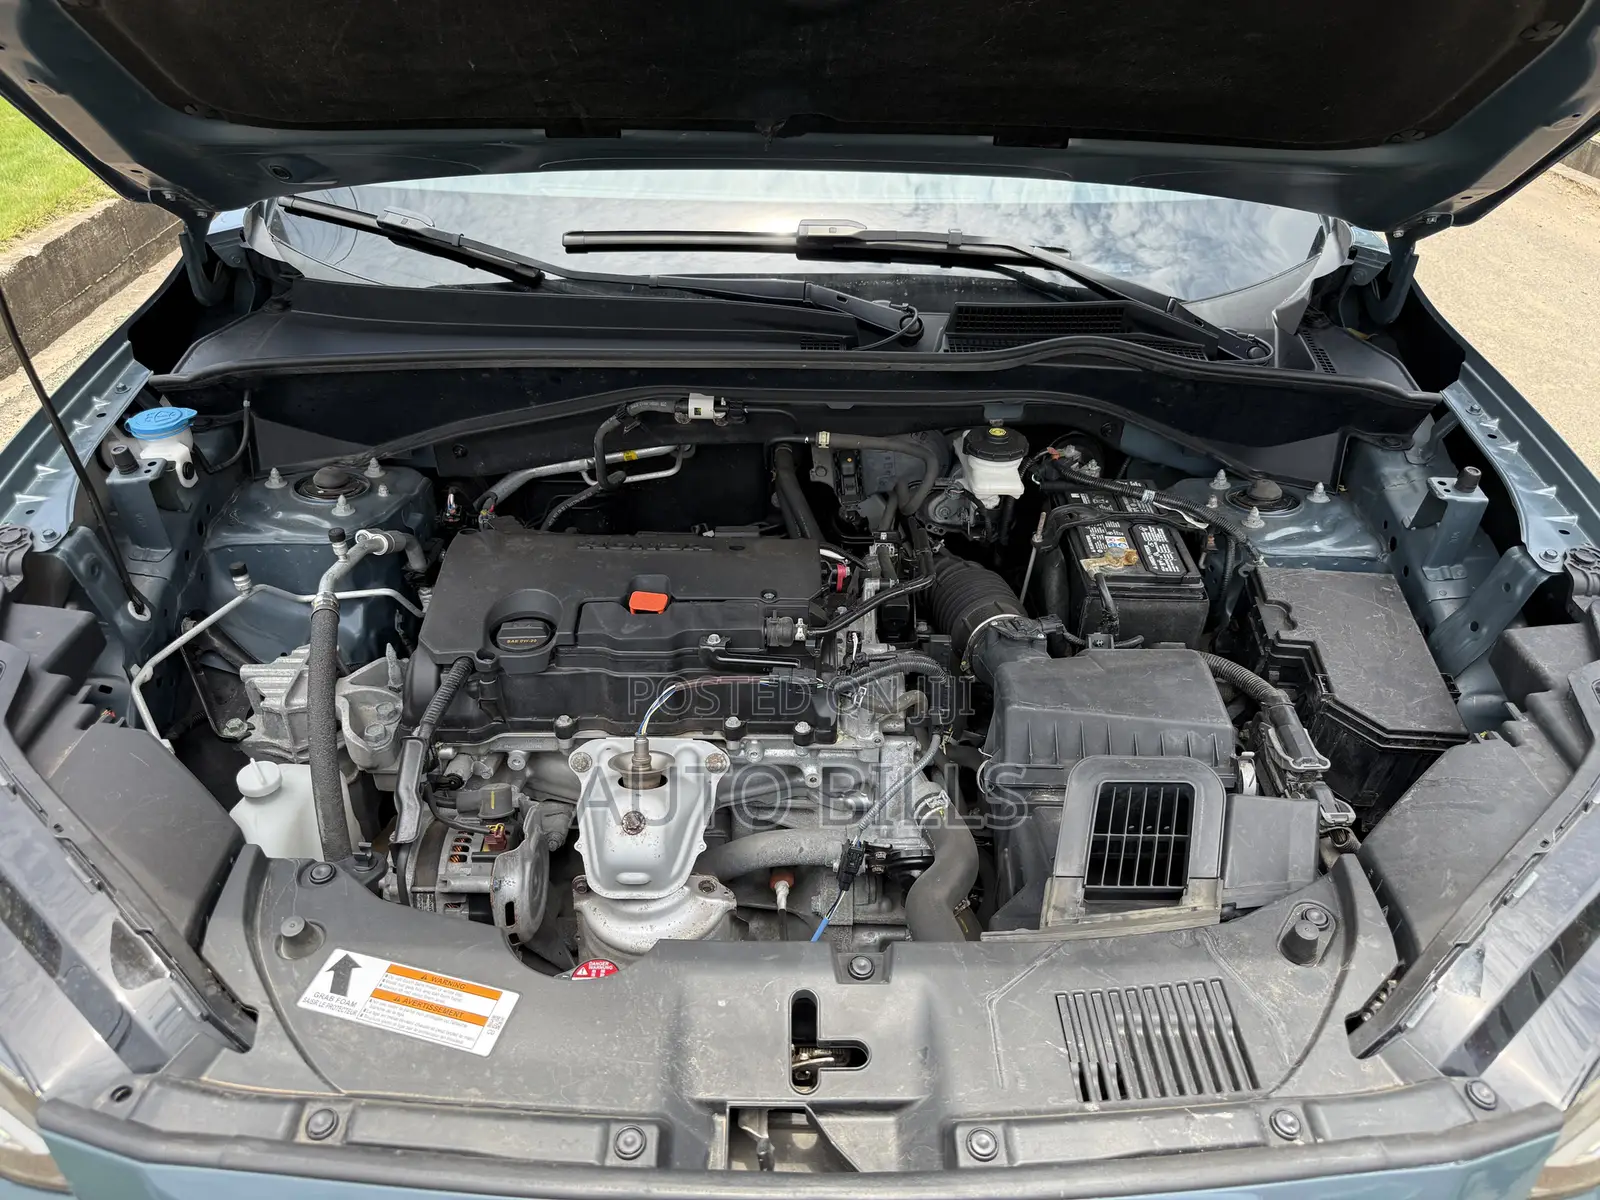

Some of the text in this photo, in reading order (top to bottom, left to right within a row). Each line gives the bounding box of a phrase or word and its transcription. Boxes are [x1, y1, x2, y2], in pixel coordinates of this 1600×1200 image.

[430, 975, 468, 991] WARNING
[302, 996, 320, 1006] SAISIR
[318, 1000, 328, 1009] LE
[325, 1002, 359, 1016] PROTECTEUR
[313, 991, 358, 1008] GRAB FOAM
[402, 996, 464, 1019] AVERTISSEMENT
